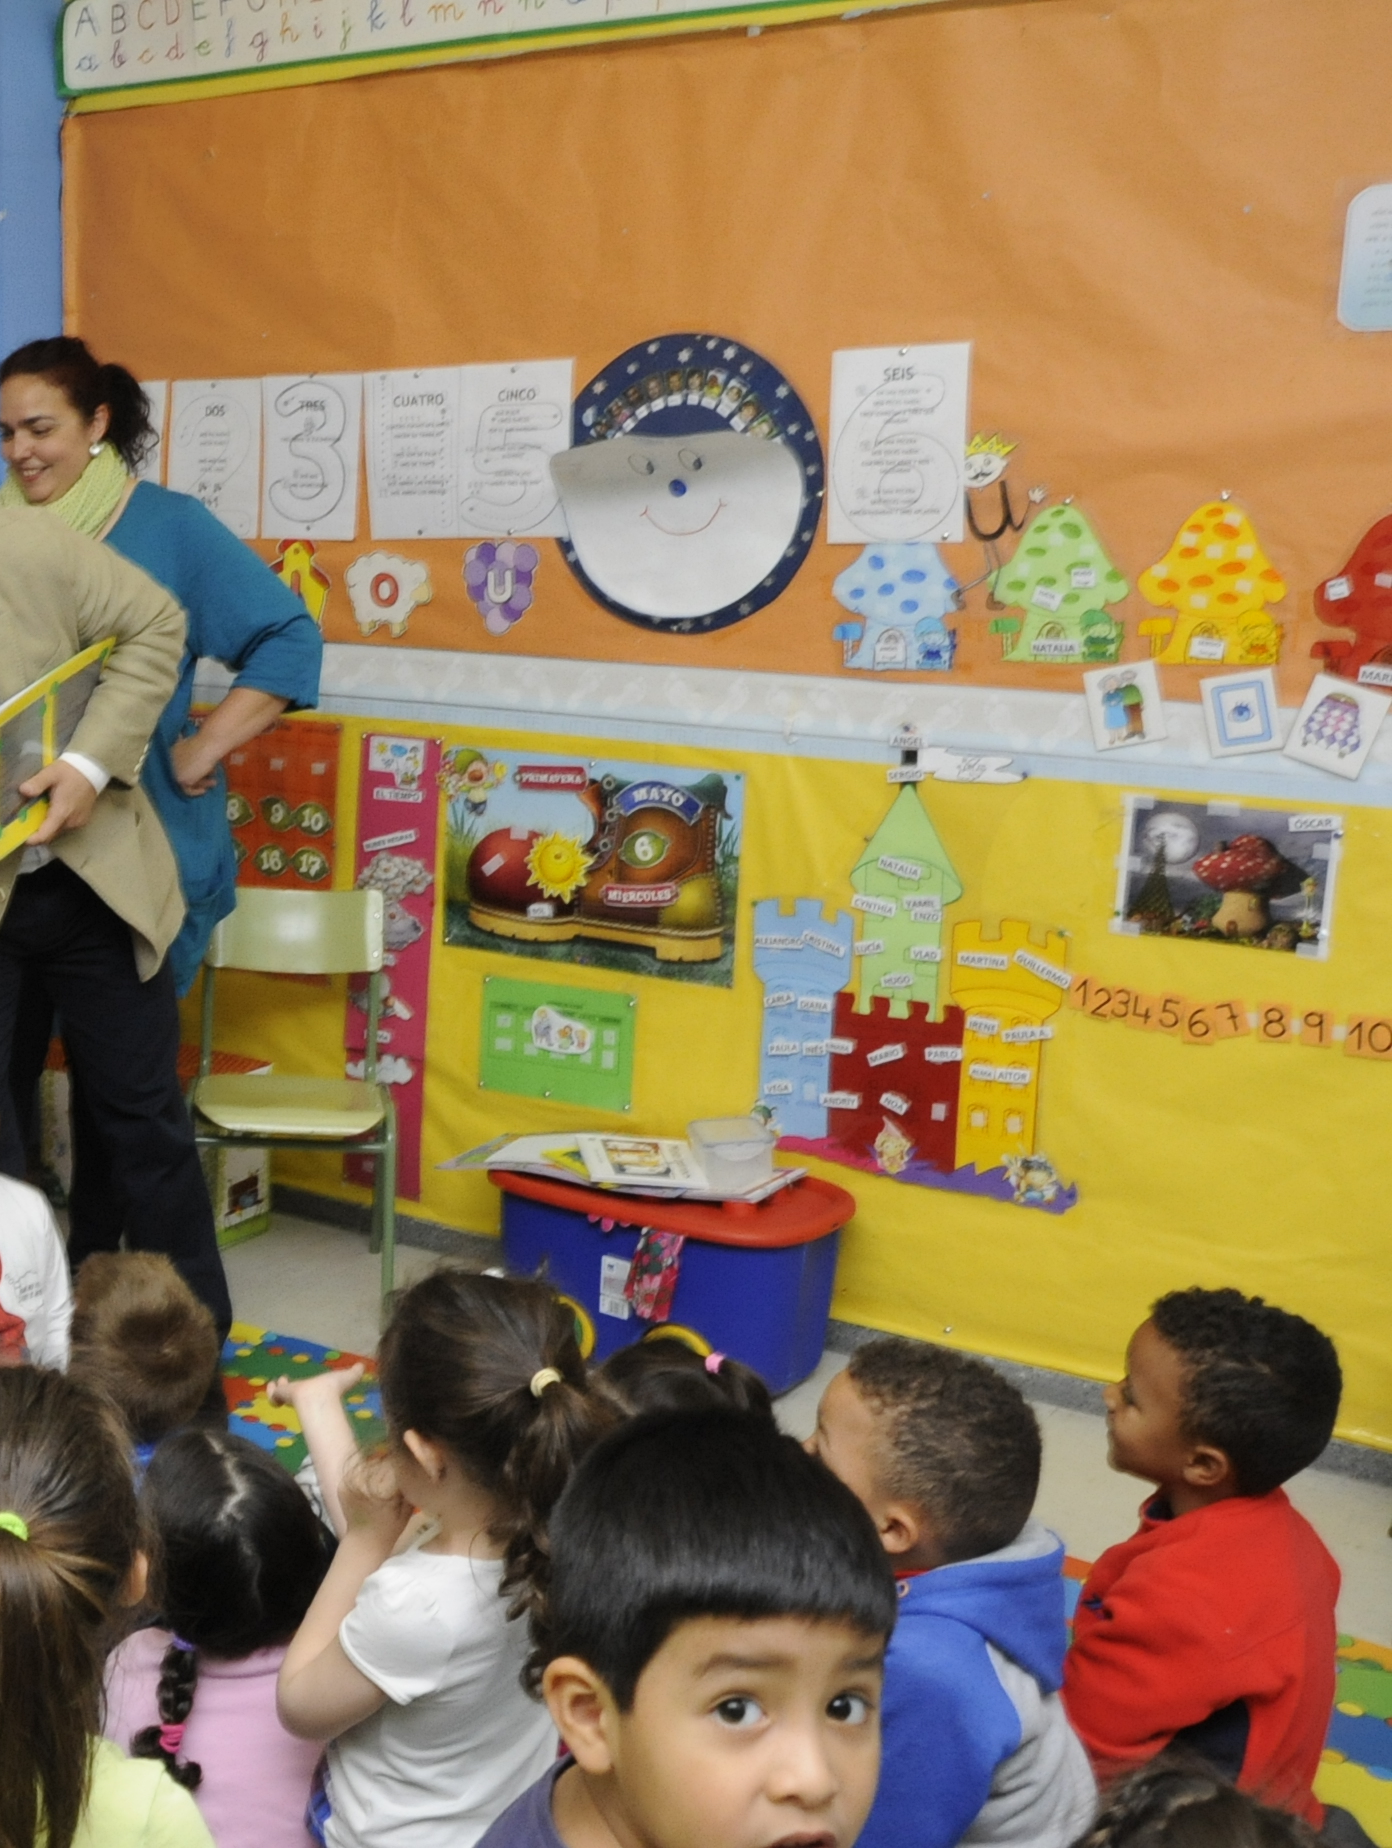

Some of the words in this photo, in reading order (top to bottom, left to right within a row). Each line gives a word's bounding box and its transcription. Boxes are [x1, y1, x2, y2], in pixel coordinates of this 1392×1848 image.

[75, 7, 97, 38] A
[111, 4, 127, 35] B
[138, 0, 155, 31] C
[165, 0, 180, 26] D
[883, 366, 915, 382] SEIS
[393, 393, 444, 408] CUATRO
[498, 388, 536, 403] CINCO
[487, 569, 514, 604] U
[1033, 644, 1076, 653] NATALIA
[521, 772, 583, 785] PRIMAVERA
[632, 787, 686, 807] MAYO
[270, 803, 284, 823] 9
[302, 809, 323, 832] 10
[634, 835, 654, 861] 6
[260, 851, 282, 871] 16
[299, 854, 322, 877] 17
[879, 858, 920, 878] NATALIA
[913, 911, 939, 922] ENZO
[803, 932, 841, 955] CRISTINA
[913, 949, 938, 960] VLAD
[959, 954, 1006, 968] MARTINA
[1015, 953, 1069, 986] GUILLERMO
[800, 1000, 828, 1011] DIANA
[1075, 979, 1088, 1006] 1
[1091, 987, 1112, 1018] 2
[1110, 989, 1129, 1018] 3
[1132, 995, 1151, 1024] 4
[1158, 998, 1180, 1028] 5
[1188, 1008, 1210, 1037] 6
[1214, 1003, 1239, 1032] 7
[1262, 1007, 1287, 1038] 8
[1303, 1011, 1324, 1042] 9
[1348, 1020, 1392, 1052] 10
[869, 1048, 900, 1064] MARIO
[927, 1050, 958, 1059] PABLO
[883, 1096, 905, 1112] NOA
